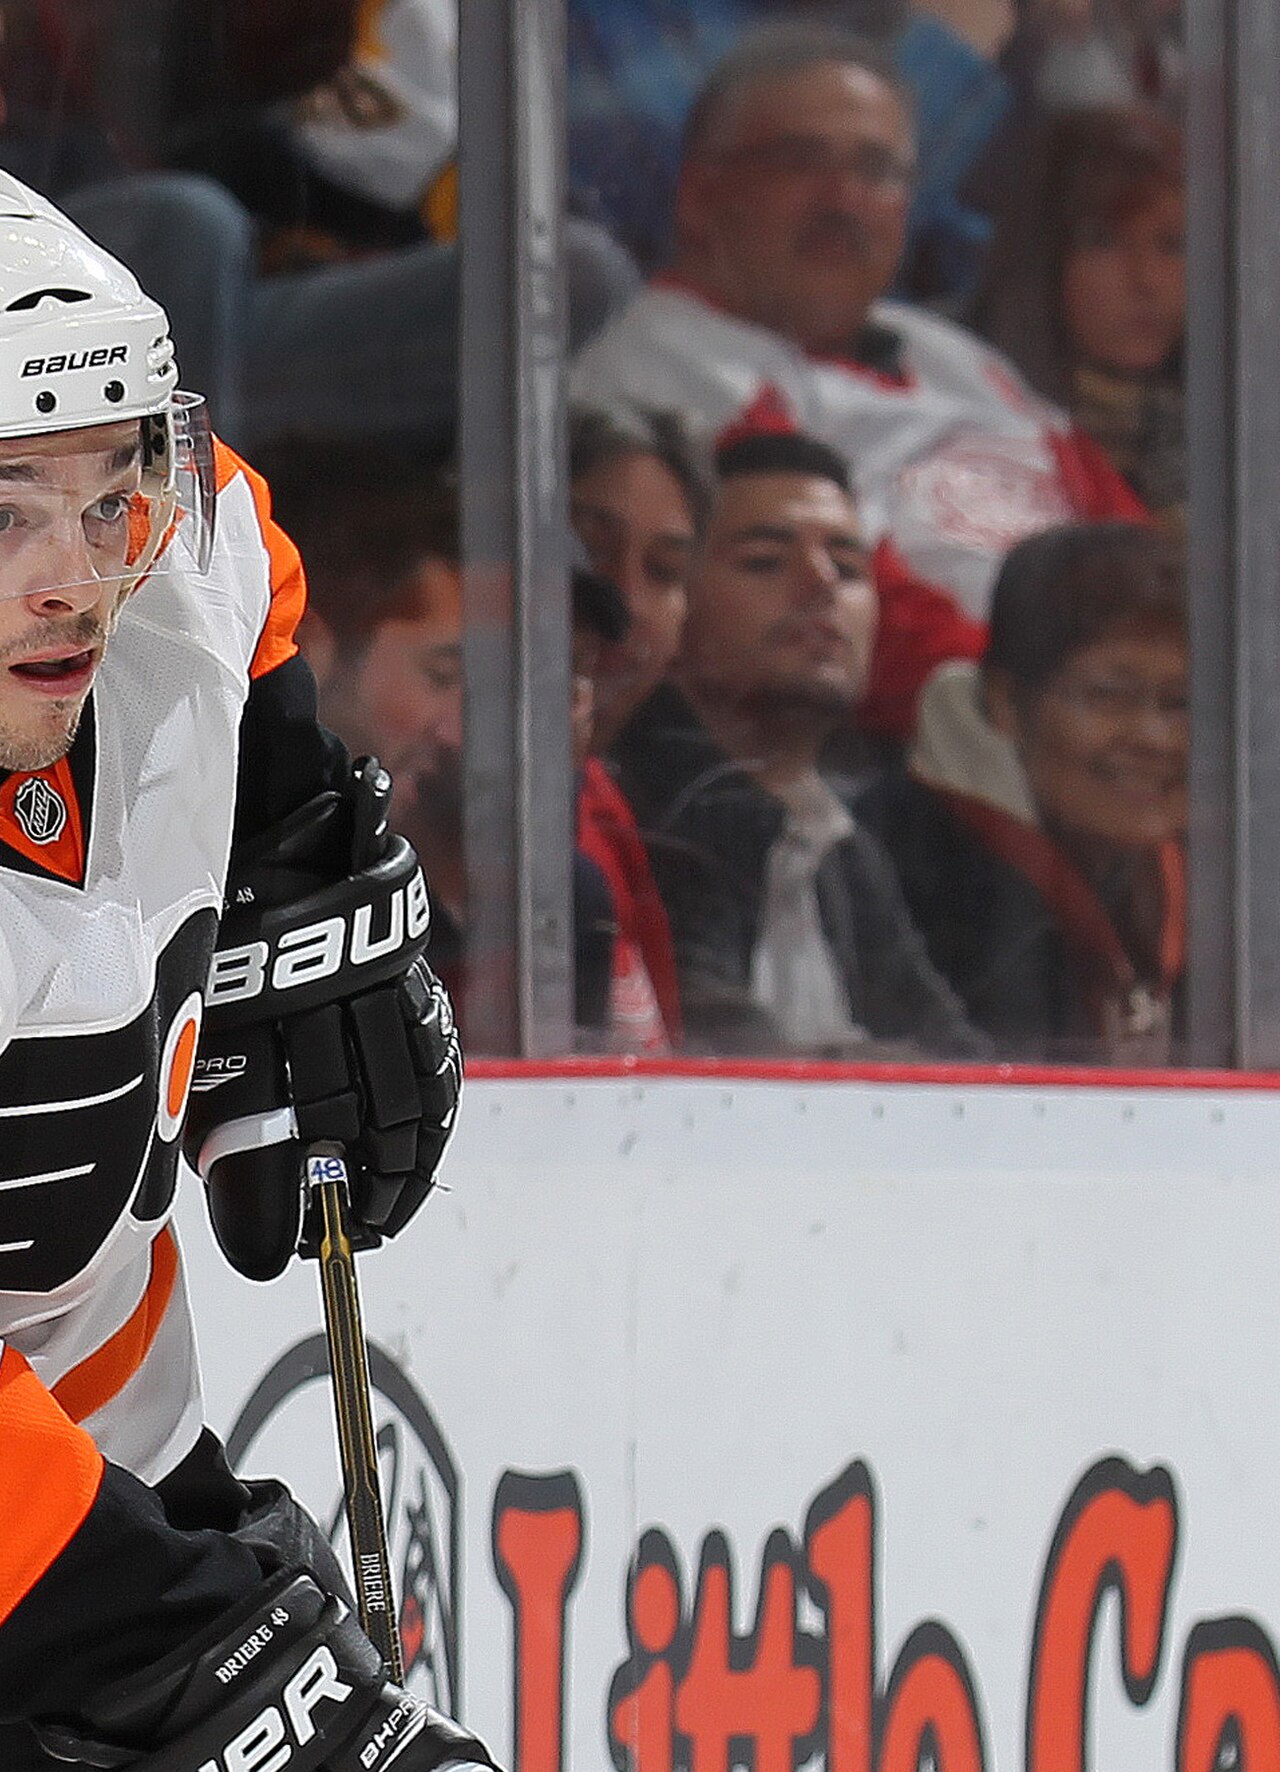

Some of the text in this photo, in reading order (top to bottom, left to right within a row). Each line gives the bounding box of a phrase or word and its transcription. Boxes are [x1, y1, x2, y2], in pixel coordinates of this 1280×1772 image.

[21, 345, 127, 378] BAUER
[236, 886, 255, 904] 48
[311, 1158, 344, 1181] 48
[360, 1553, 386, 1613] BRIERE
[215, 1607, 290, 1684] BRIERE 48
